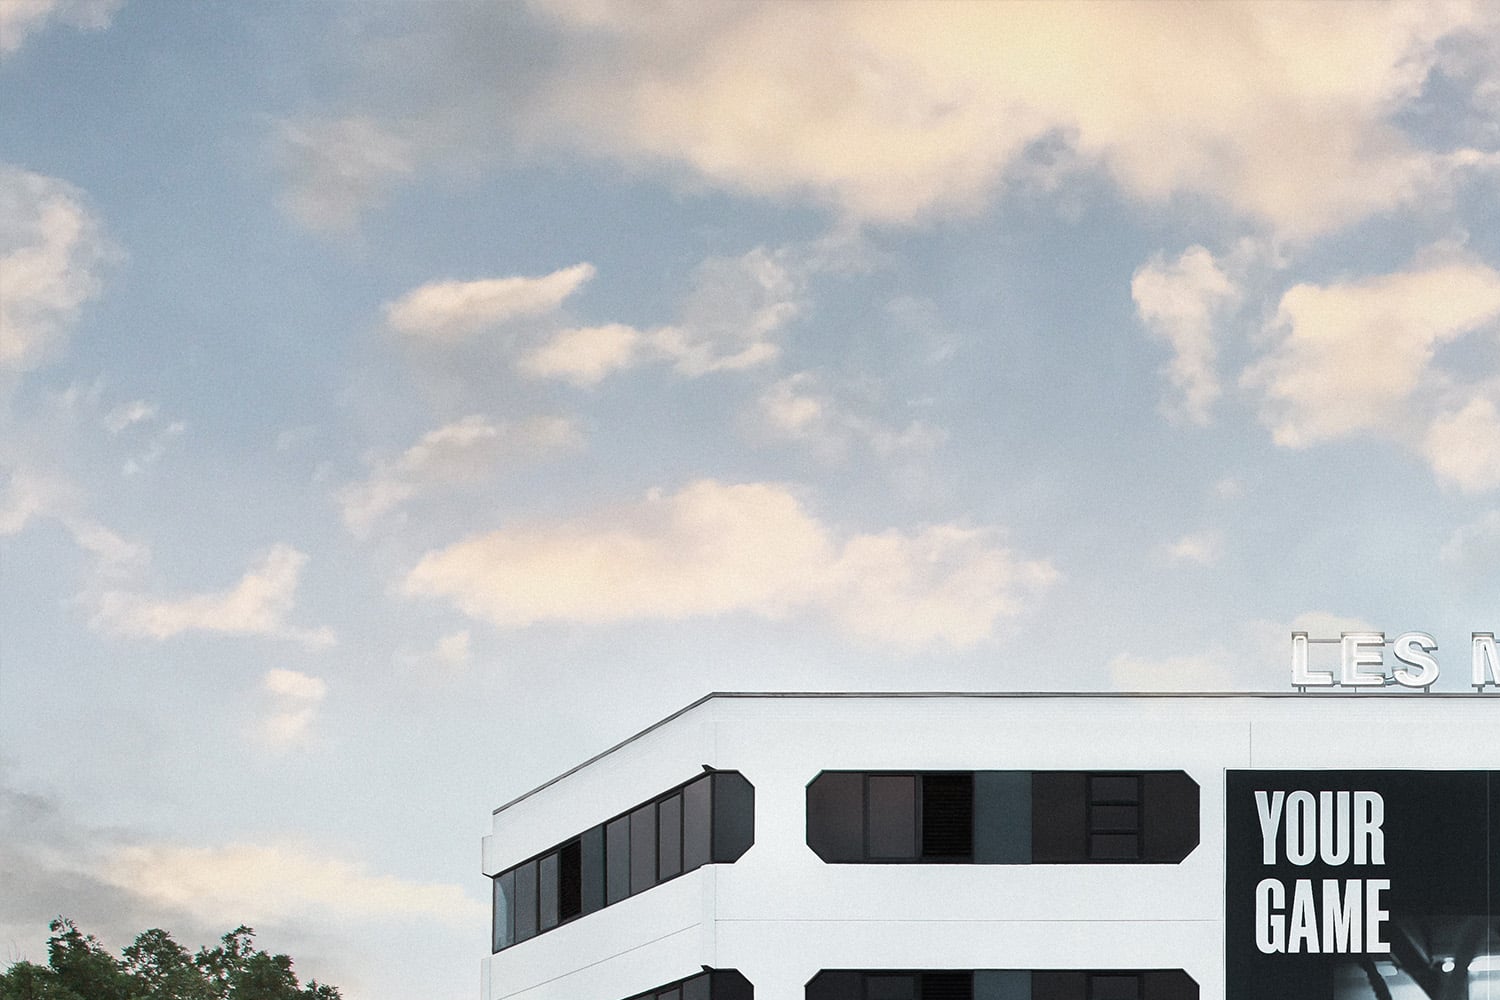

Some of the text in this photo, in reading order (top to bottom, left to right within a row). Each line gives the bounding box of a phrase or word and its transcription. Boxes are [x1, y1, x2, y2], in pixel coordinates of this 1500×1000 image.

[1291, 631, 1439, 688] LES
[1254, 790, 1386, 866] YOUR
[1255, 878, 1391, 954] GAME
